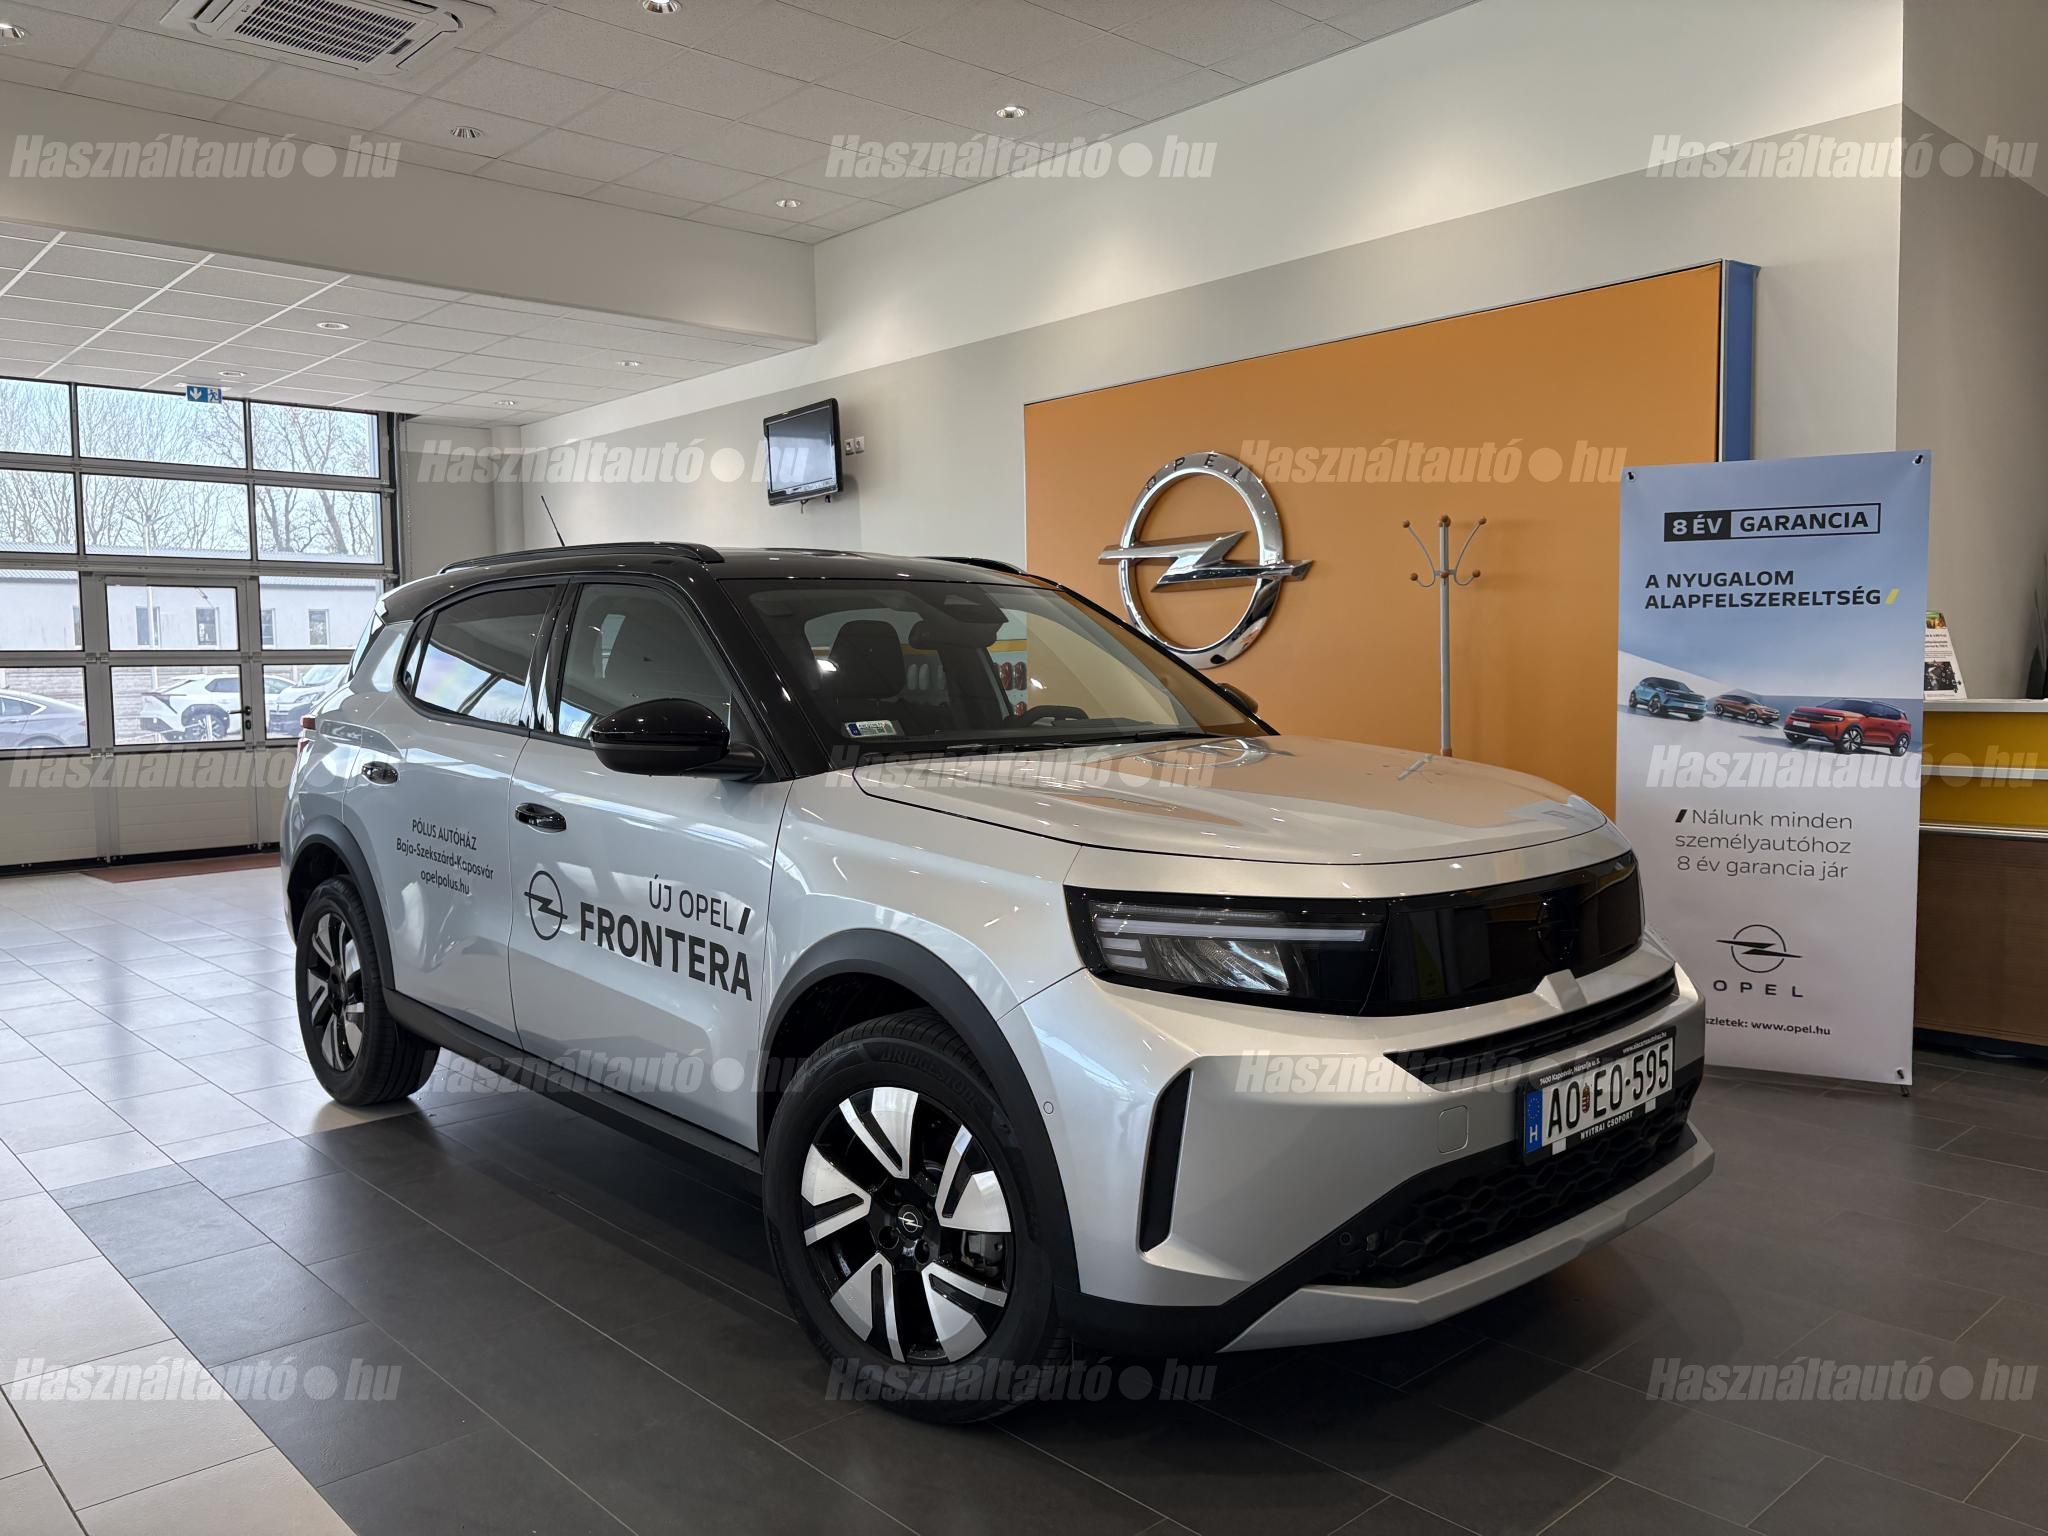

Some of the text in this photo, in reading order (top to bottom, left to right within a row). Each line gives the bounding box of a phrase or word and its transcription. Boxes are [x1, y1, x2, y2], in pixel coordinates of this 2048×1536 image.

[1672, 515, 1723, 535] 8 ÉV
[1739, 512, 1869, 534] GARANCIA
[1645, 570, 1795, 589] A NYUGALOM
[1645, 586, 1882, 609] ALAPFELSZERELTSÉG
[1692, 807, 1853, 830] Nálunk minden
[412, 819, 477, 851] PÓLUS AUTÓHÁZ
[1675, 833, 1852, 855] személyautóhoz
[396, 837, 494, 881] Baja-Szekszárd-Kaposvár
[1677, 856, 1849, 881] 8 év garancia jár
[420, 868, 471, 896] opelpolus.hu
[648, 873, 735, 932] ÚJ OPEL
[580, 901, 754, 1002] FRONTERA
[1713, 979, 1804, 998] OPEL
[1751, 1021, 1831, 1035] www.opel.hu
[1529, 1126, 1538, 1144] H
[1580, 1110, 1633, 1140] NYITRAI CSOPORT
